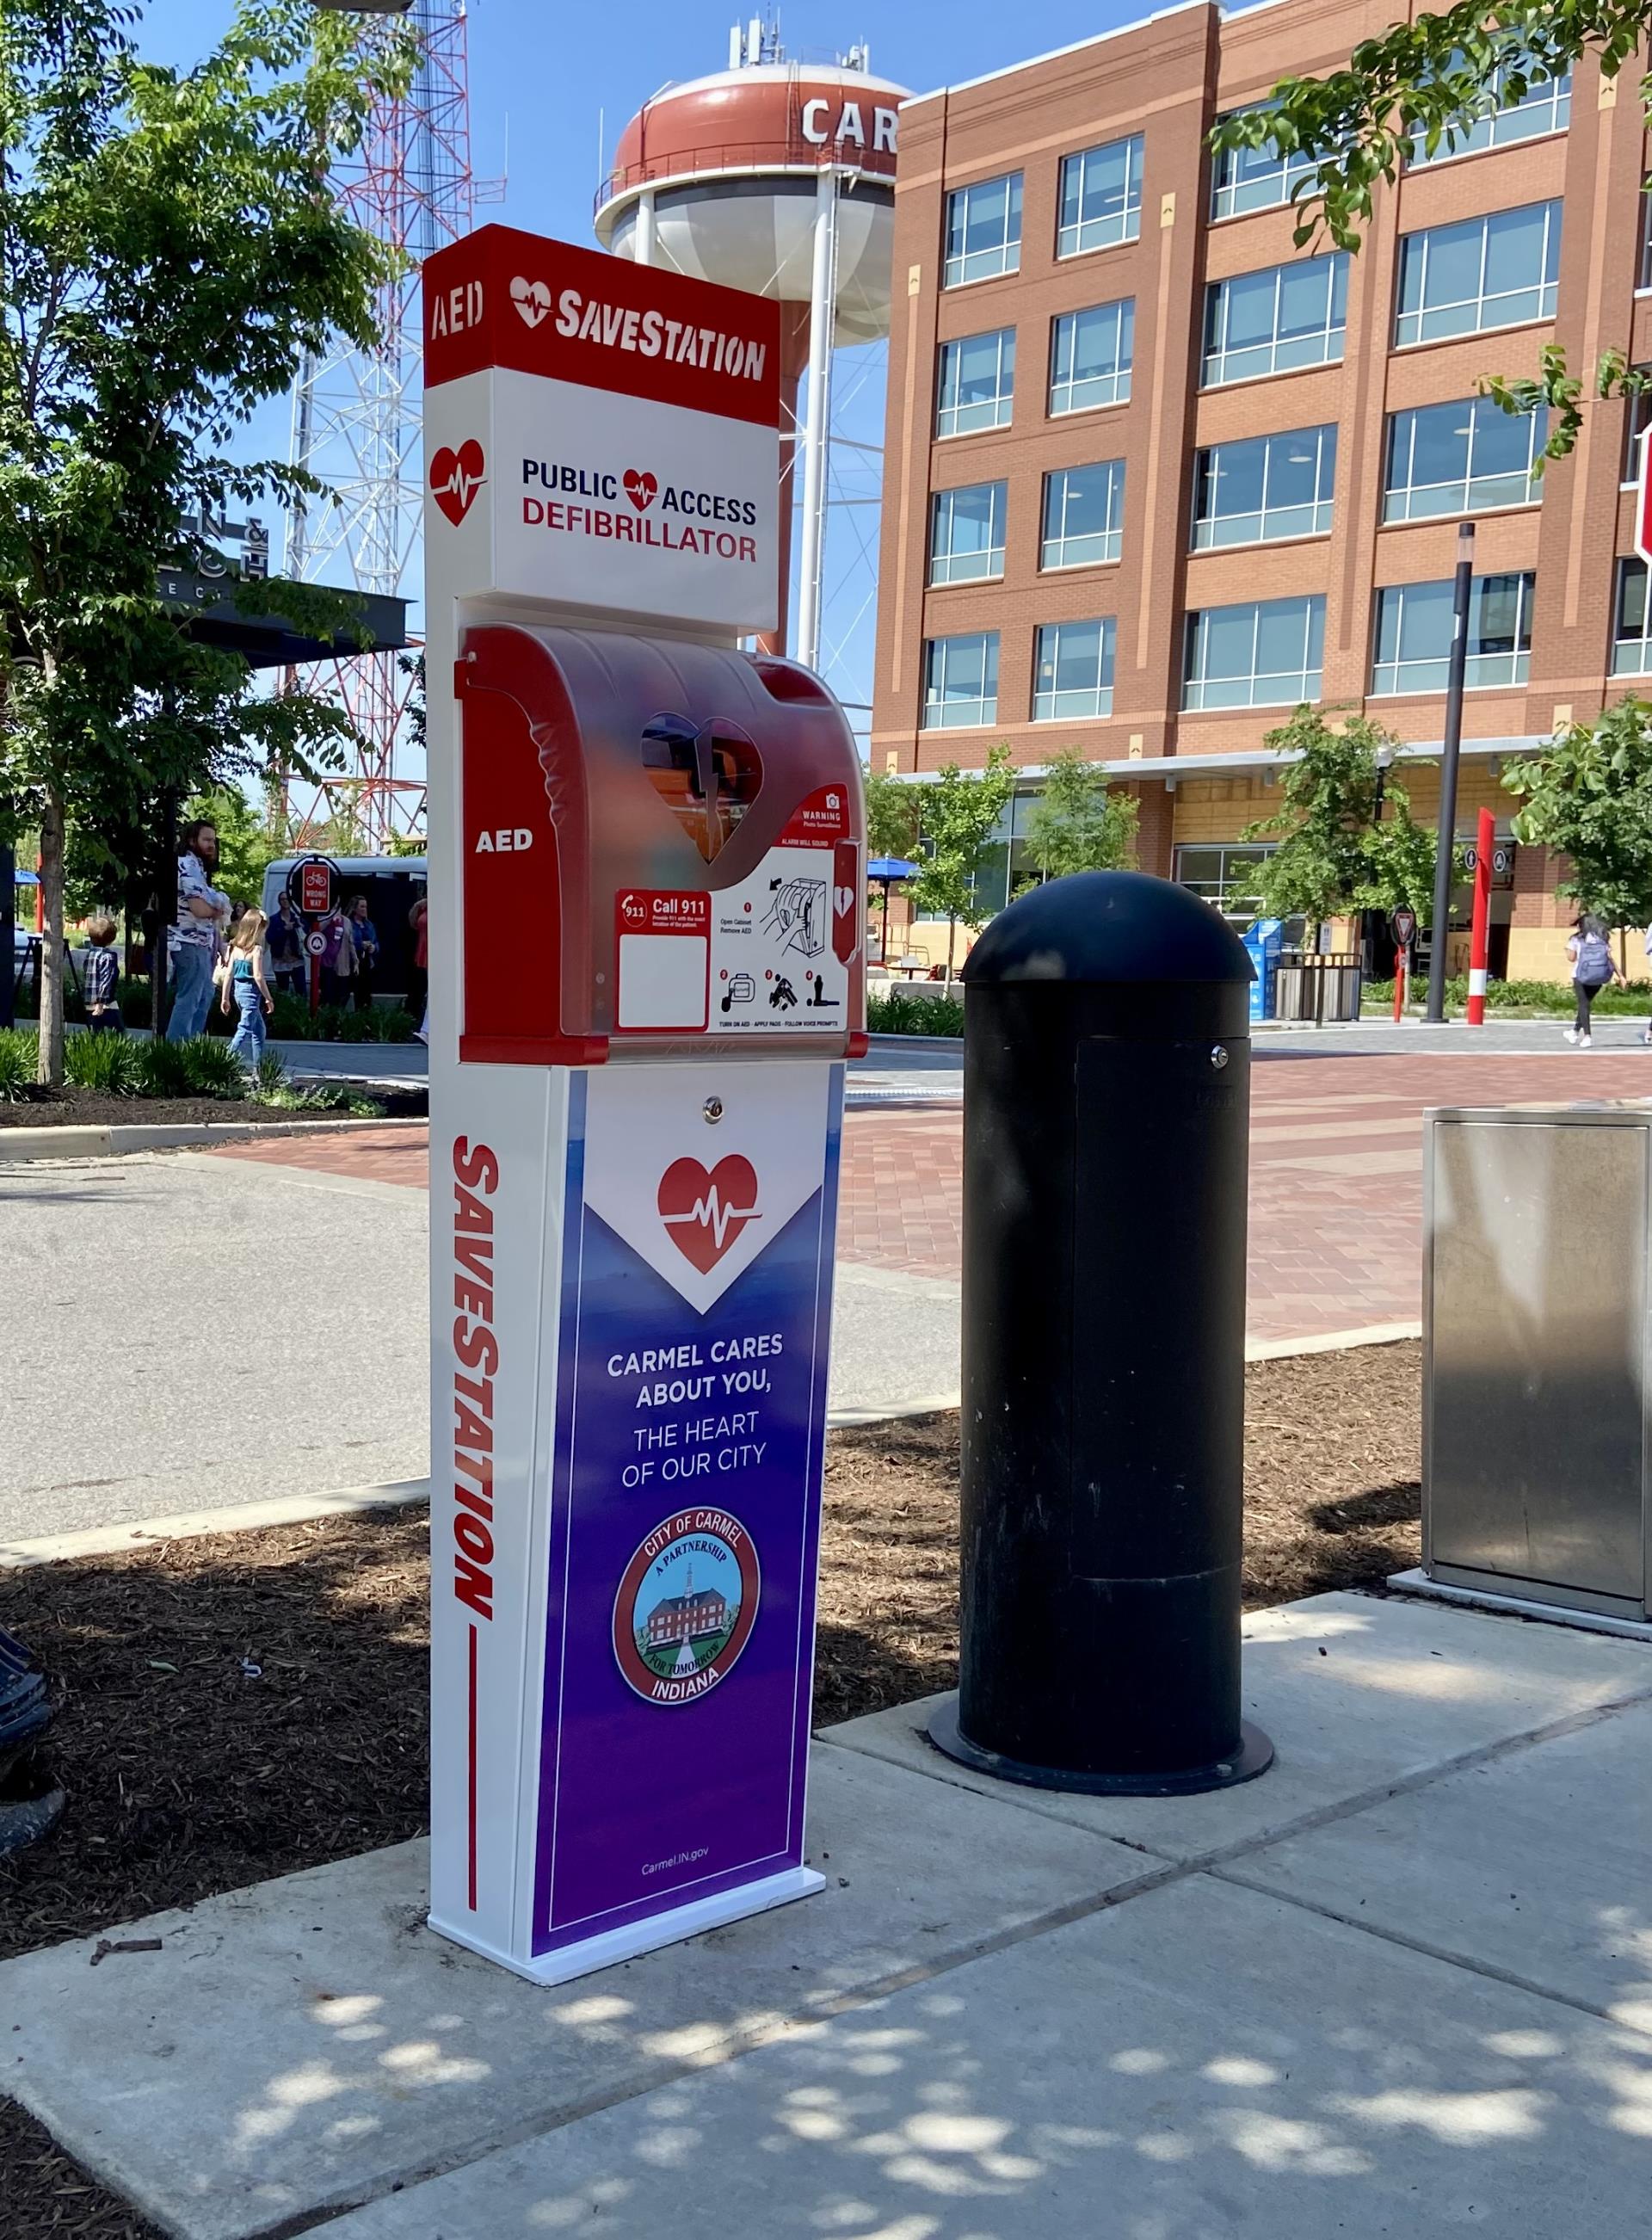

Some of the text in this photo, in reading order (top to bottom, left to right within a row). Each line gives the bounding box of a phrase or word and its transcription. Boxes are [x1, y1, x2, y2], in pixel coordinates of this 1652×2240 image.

[431, 281, 484, 340] AED
[555, 289, 767, 382] SAVESTATION
[521, 459, 757, 526] PUBLIC ACCESS
[521, 497, 757, 563] DEFIBRILLATOR
[802, 811, 841, 821] WARNING
[475, 829, 533, 854] AED
[305, 890, 327, 898] WRONG
[626, 906, 644, 917] 911
[652, 898, 705, 915] Call 911
[607, 1334, 783, 1378] CARMEL CARES
[453, 1135, 499, 1623] SAVESTATION
[635, 1367, 772, 1409] ABOUT YOU,
[633, 1410, 760, 1452] THE HEART
[621, 1441, 767, 1488] OF OUR CITY
[644, 1511, 743, 1557] CITY OF CARMEL
[655, 1540, 728, 1577] A PARTNERSHIP
[649, 1640, 721, 1675] FOR TOMORROW
[651, 1666, 719, 1700] INDIANA
[641, 1846, 710, 1876] Carmel.IN.gov
